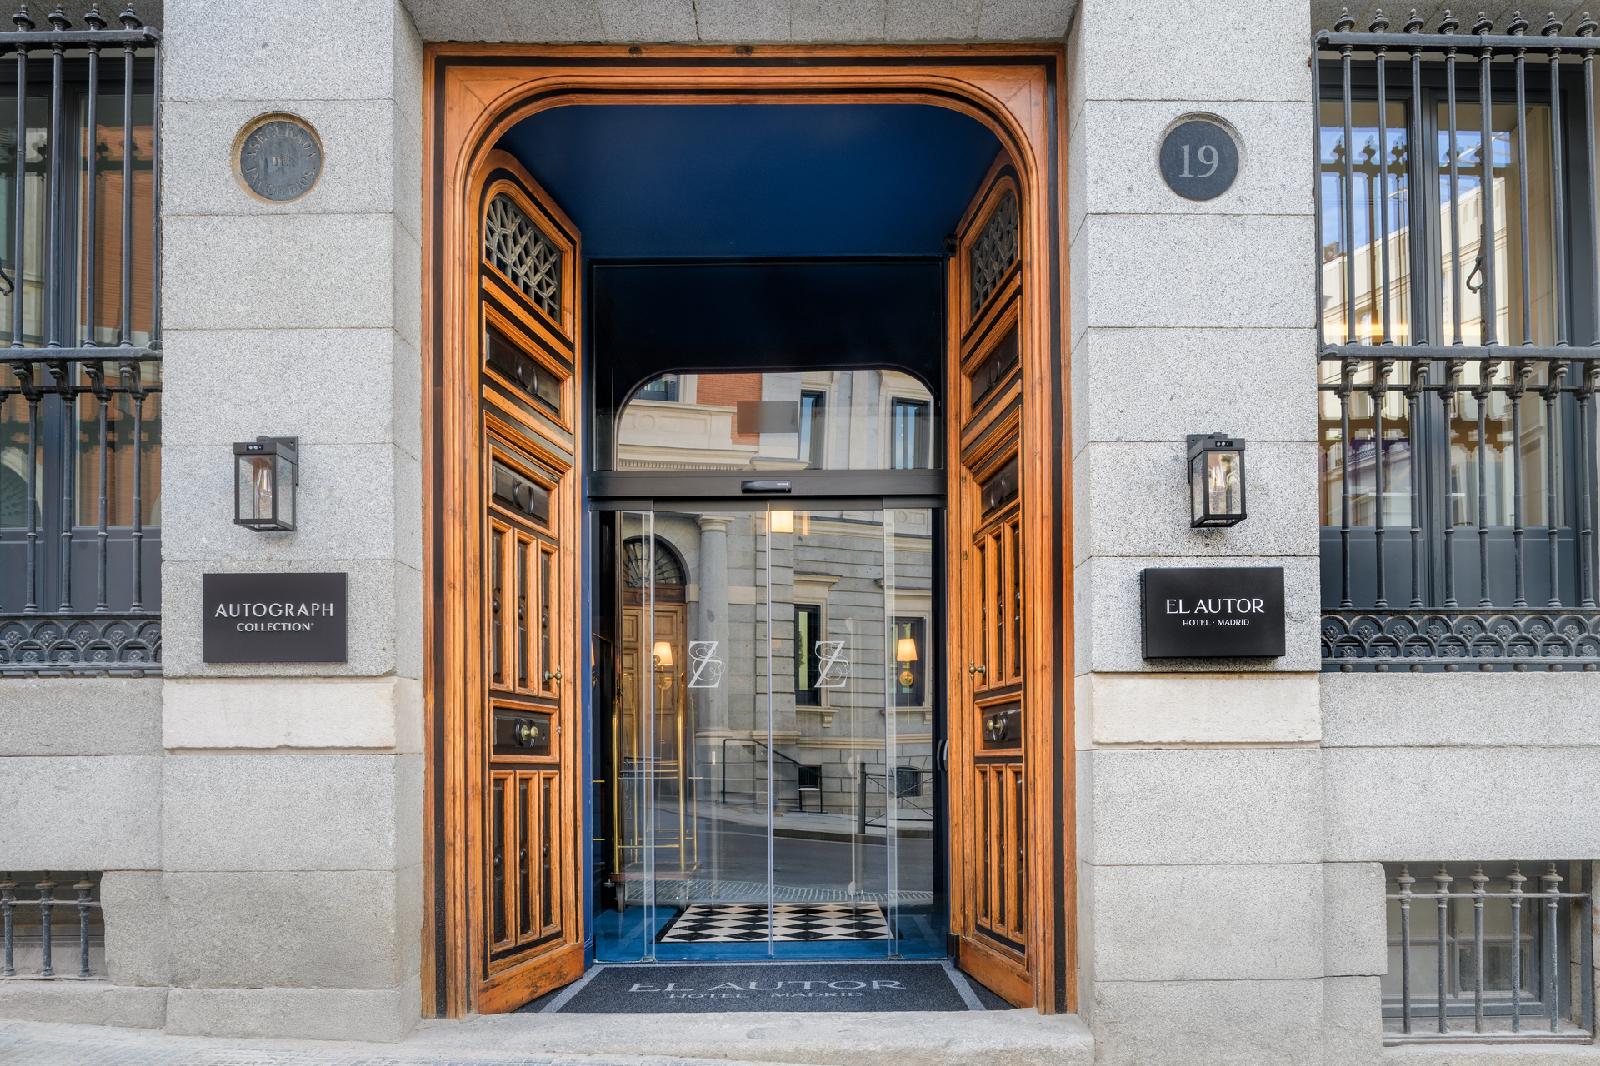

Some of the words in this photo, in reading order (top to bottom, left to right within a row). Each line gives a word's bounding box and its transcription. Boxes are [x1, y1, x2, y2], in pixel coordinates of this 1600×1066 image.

[1178, 144, 1219, 178] 19
[215, 602, 334, 618] AUTOGRAPH
[1166, 599, 1191, 614] EL
[1194, 598, 1265, 614] AUTOR
[1182, 619, 1211, 627] HOTEL
[628, 982, 694, 992] EL
[707, 980, 907, 991] AUTOR
